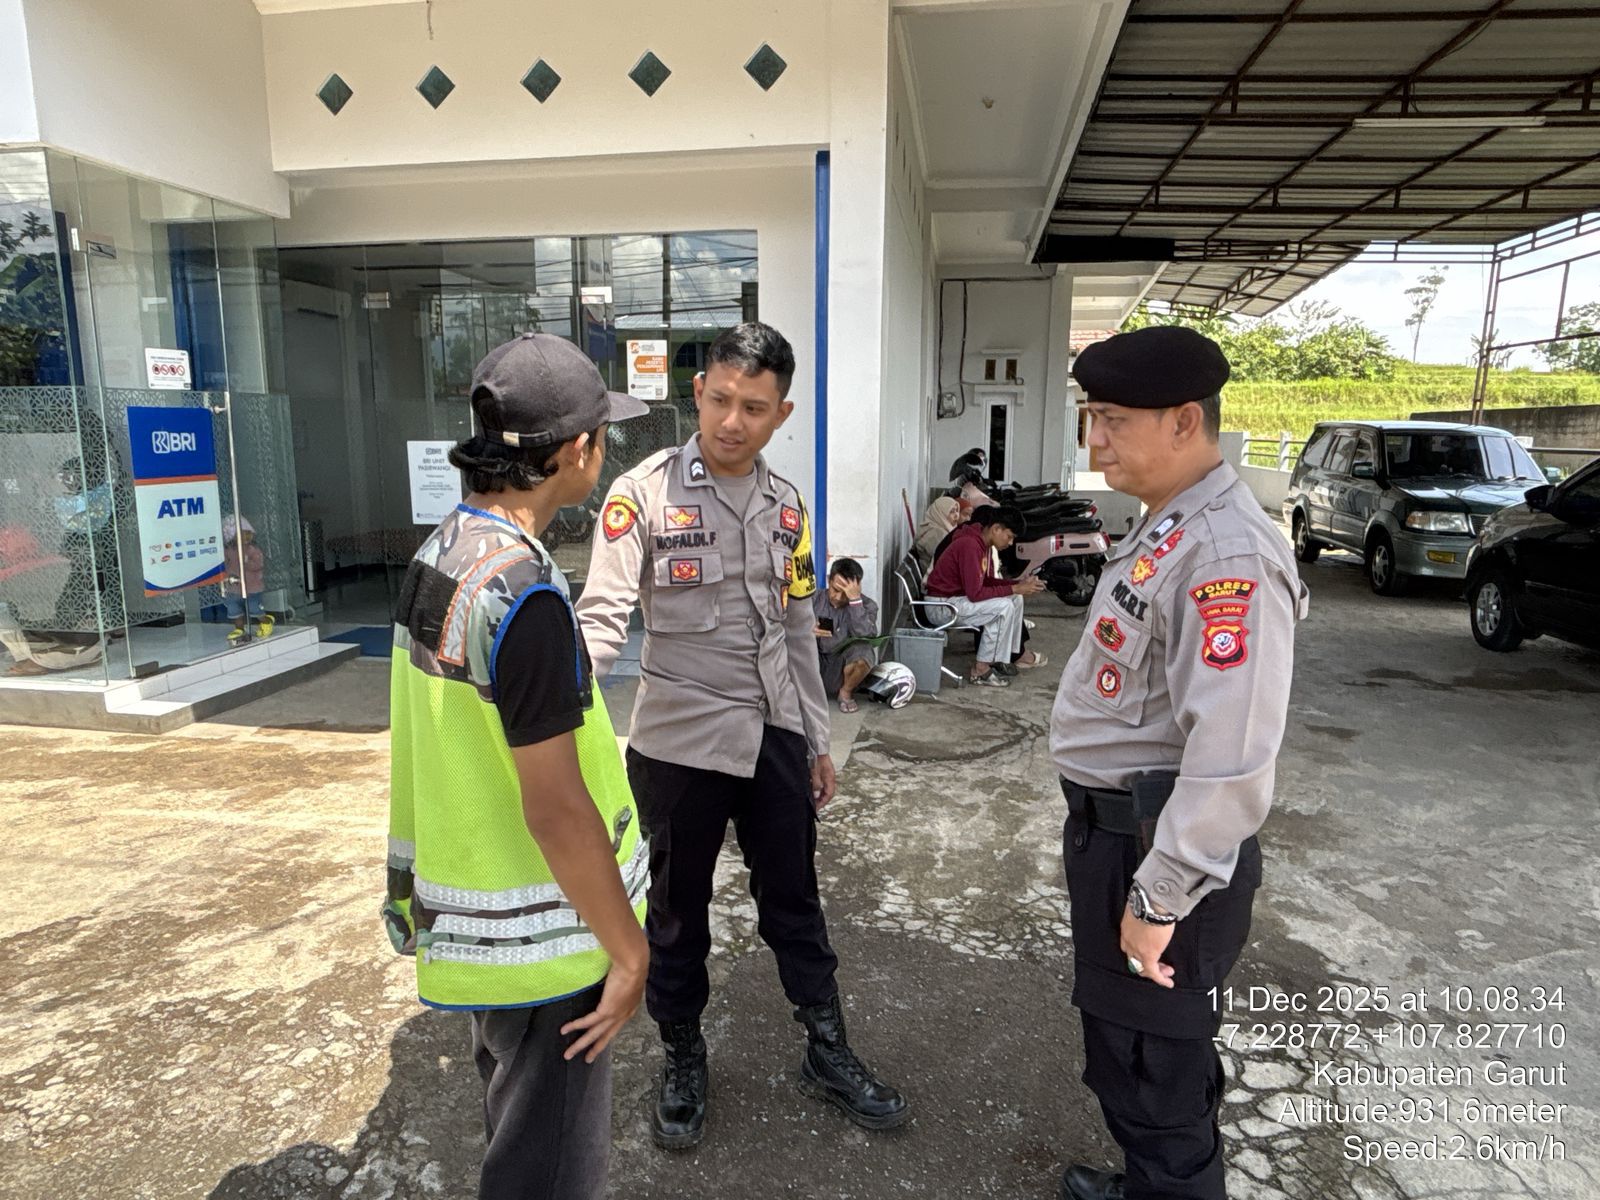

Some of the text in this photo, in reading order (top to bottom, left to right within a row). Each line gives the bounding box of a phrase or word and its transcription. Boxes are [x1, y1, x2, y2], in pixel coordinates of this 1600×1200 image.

[170, 432, 196, 452] BRI
[157, 496, 205, 519] ATM
[1195, 581, 1251, 599] POLRES
[1208, 589, 1237, 599] GARUT
